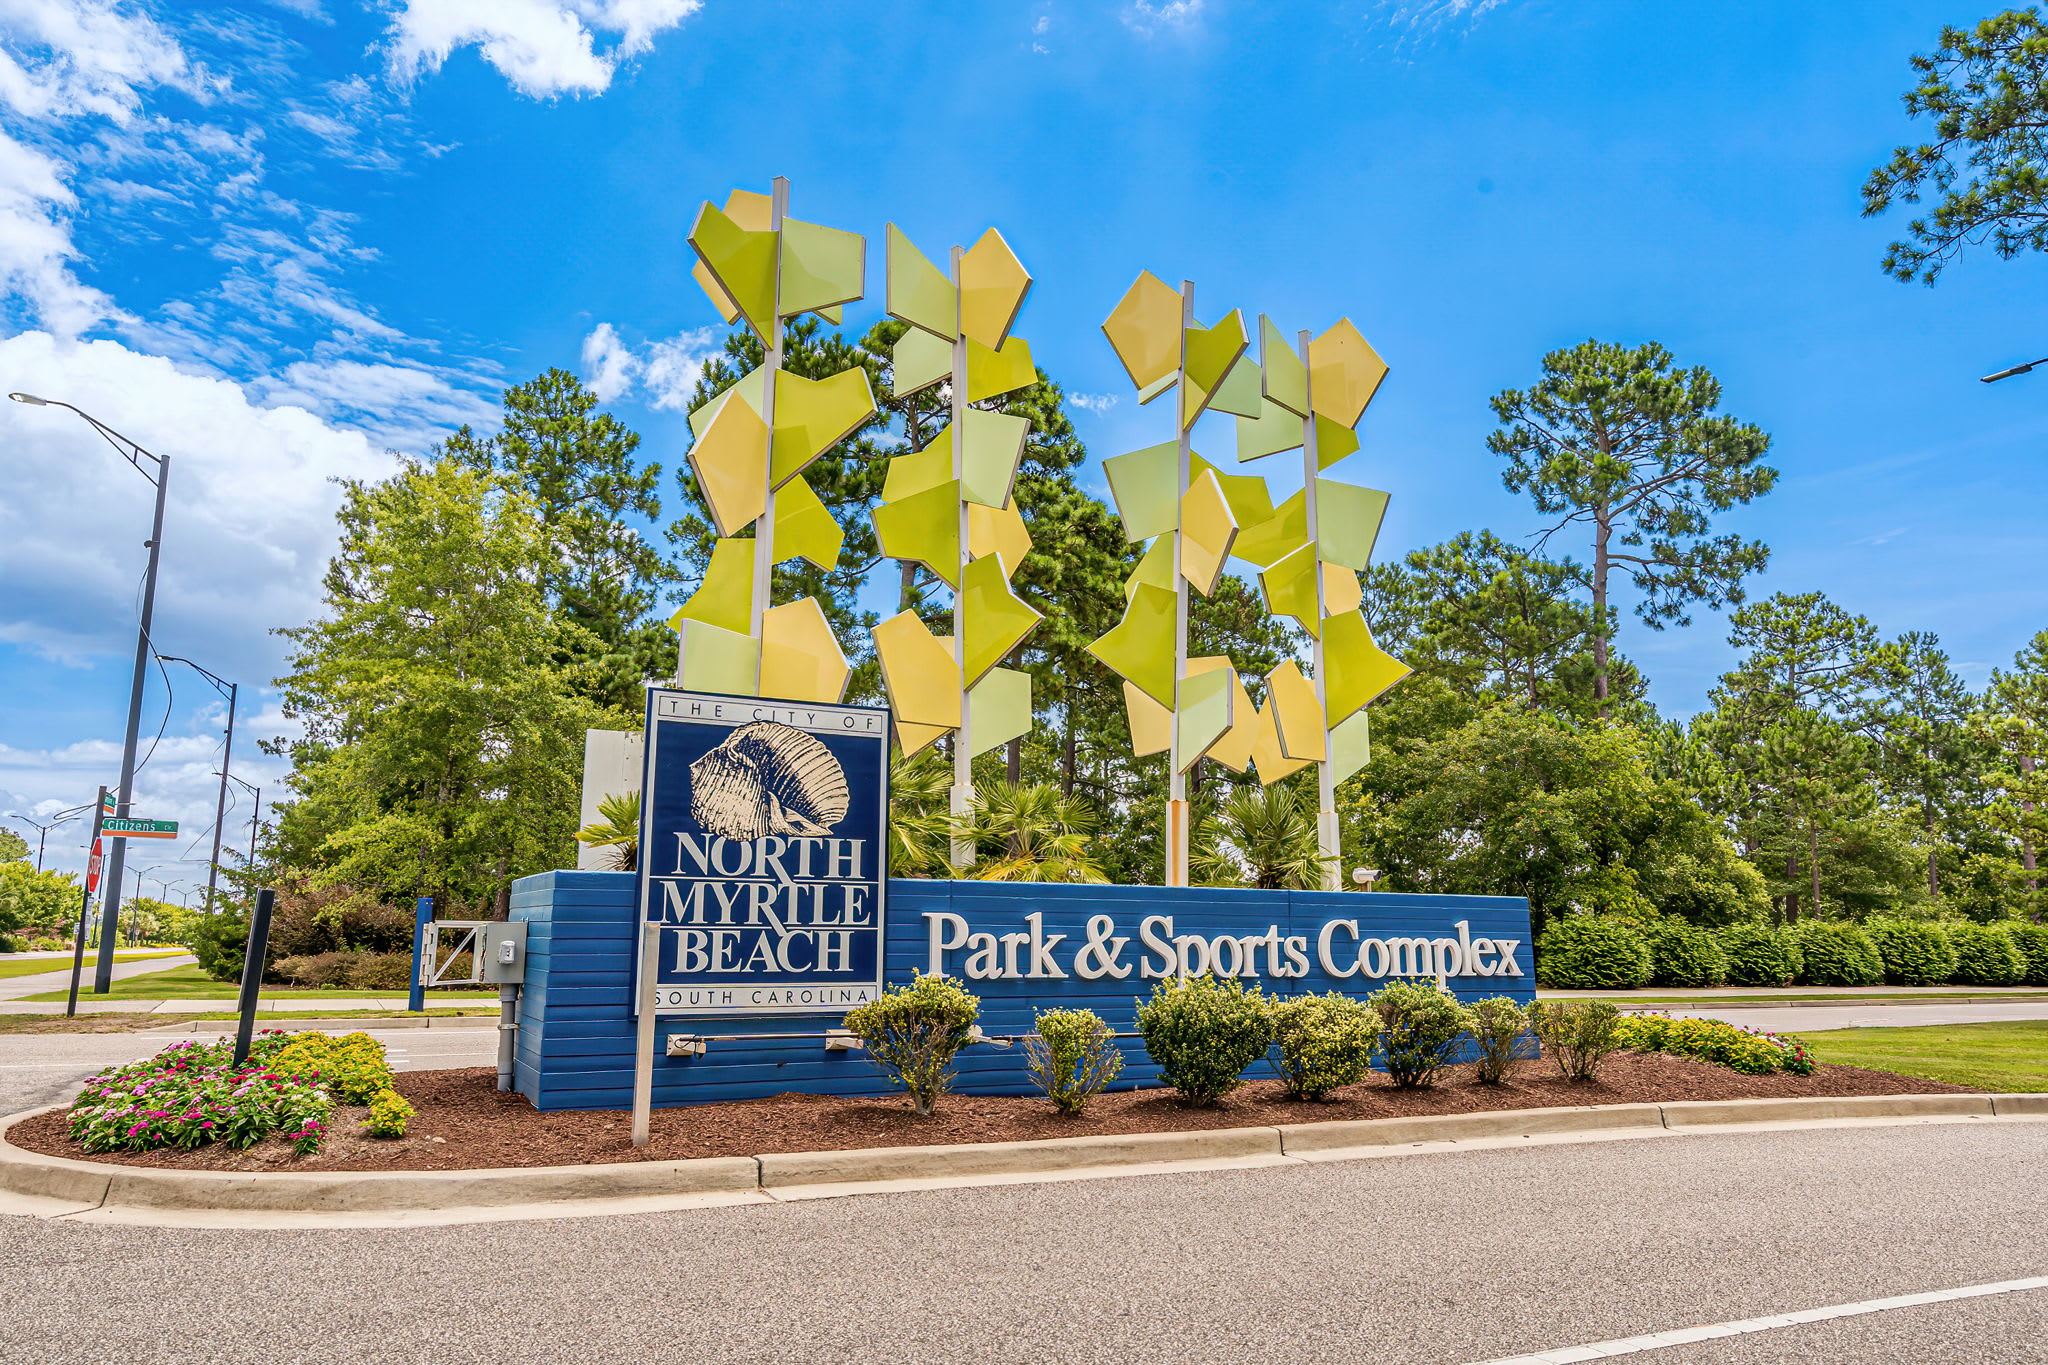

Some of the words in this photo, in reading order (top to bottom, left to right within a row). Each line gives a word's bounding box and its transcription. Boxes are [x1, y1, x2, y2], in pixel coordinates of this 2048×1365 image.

[670, 701, 722, 718] THE
[752, 708, 816, 725] CITY
[843, 716, 873, 730] OF
[108, 820, 156, 832] Citizens
[671, 832, 866, 885] NORTH
[660, 881, 871, 935] MYRTLE
[670, 929, 855, 973] BEACH
[921, 911, 1069, 980] Park
[1074, 914, 1132, 980] &
[1139, 915, 1310, 990] Sports
[1318, 919, 1524, 991] Complex
[752, 990, 868, 1004] CAROLINA
